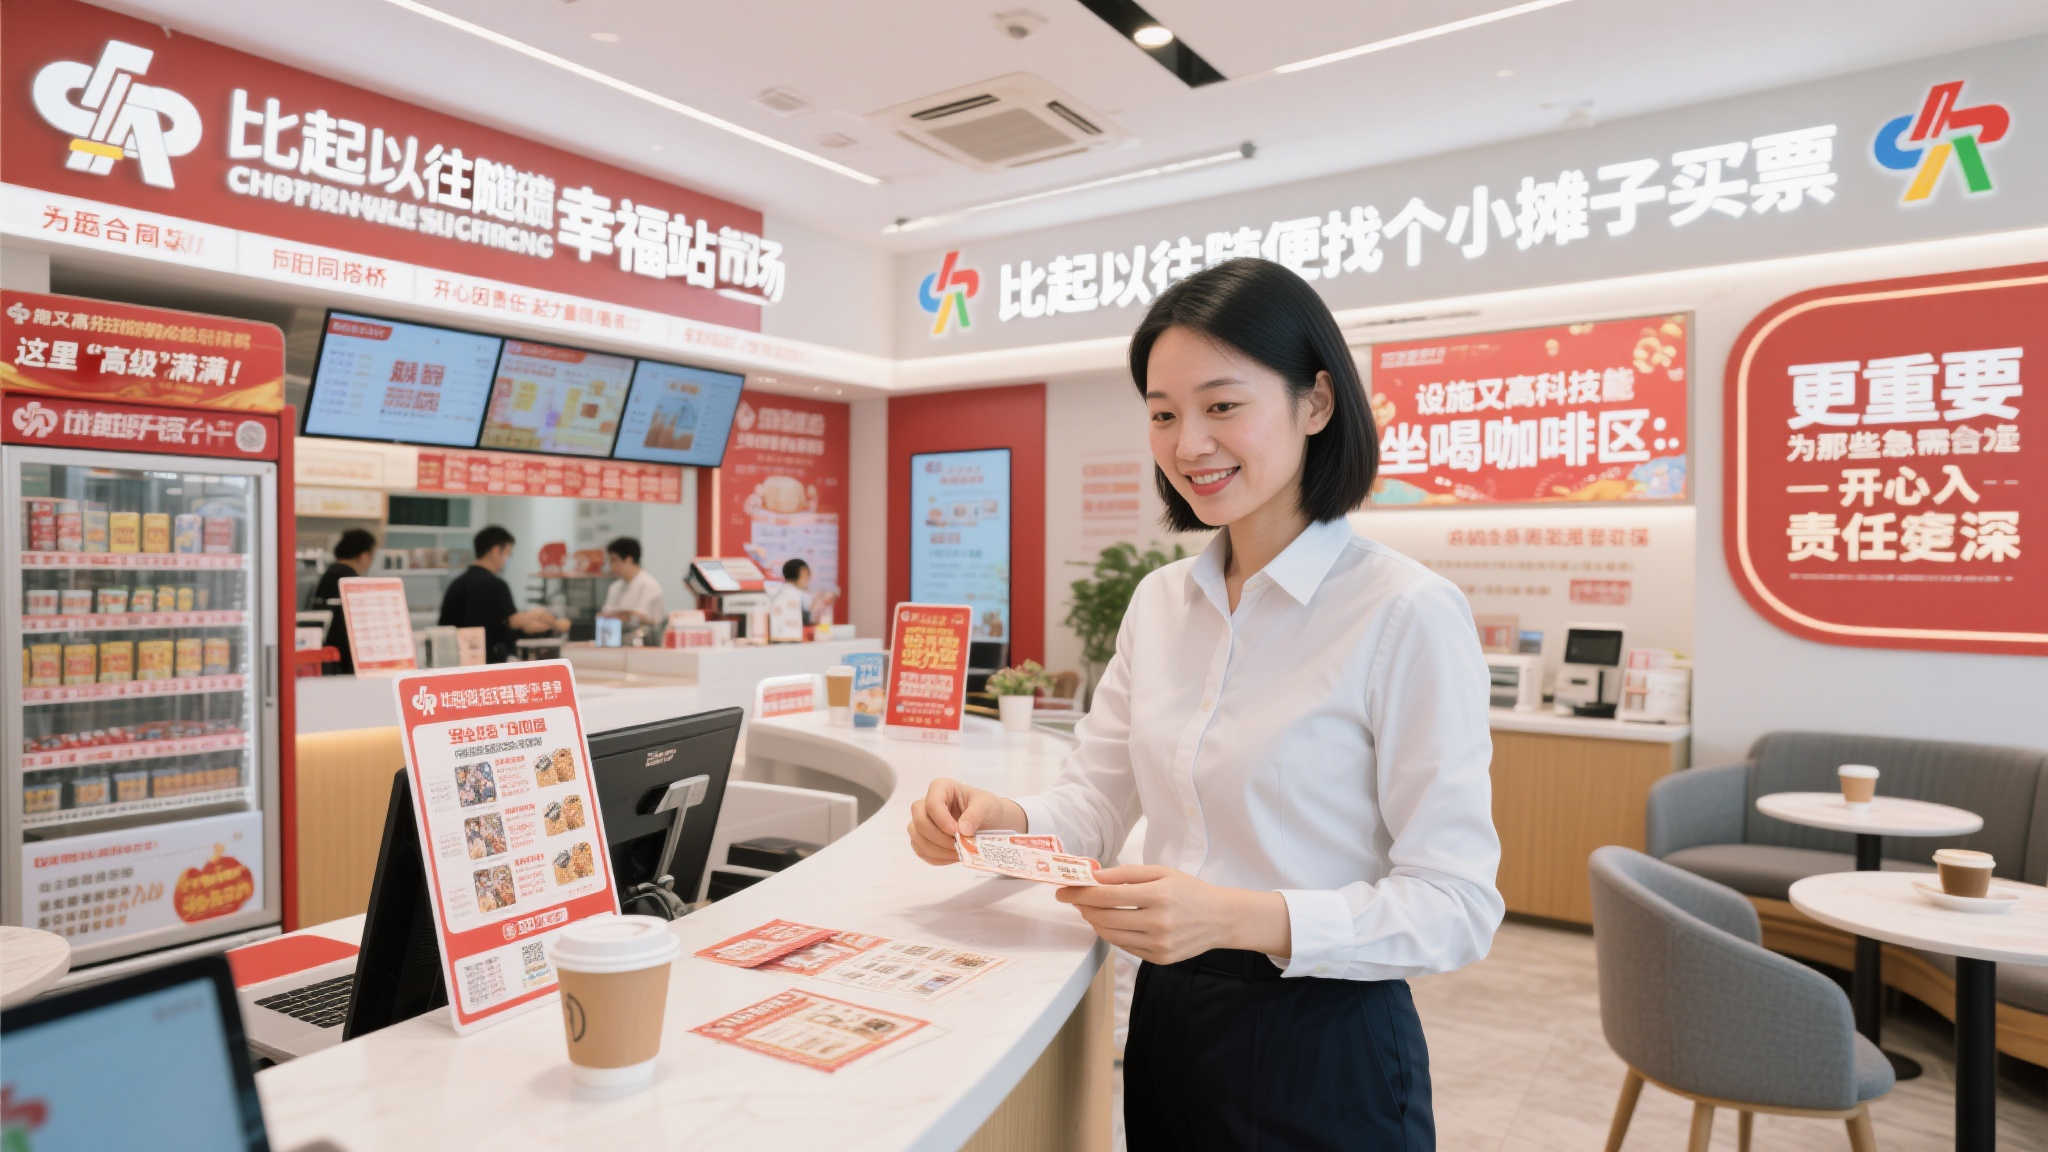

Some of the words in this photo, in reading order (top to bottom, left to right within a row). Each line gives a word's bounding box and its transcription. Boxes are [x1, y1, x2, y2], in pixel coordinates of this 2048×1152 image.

[1415, 367, 1635, 415] 设施又高科技能
[1786, 346, 2024, 430] 更重要
